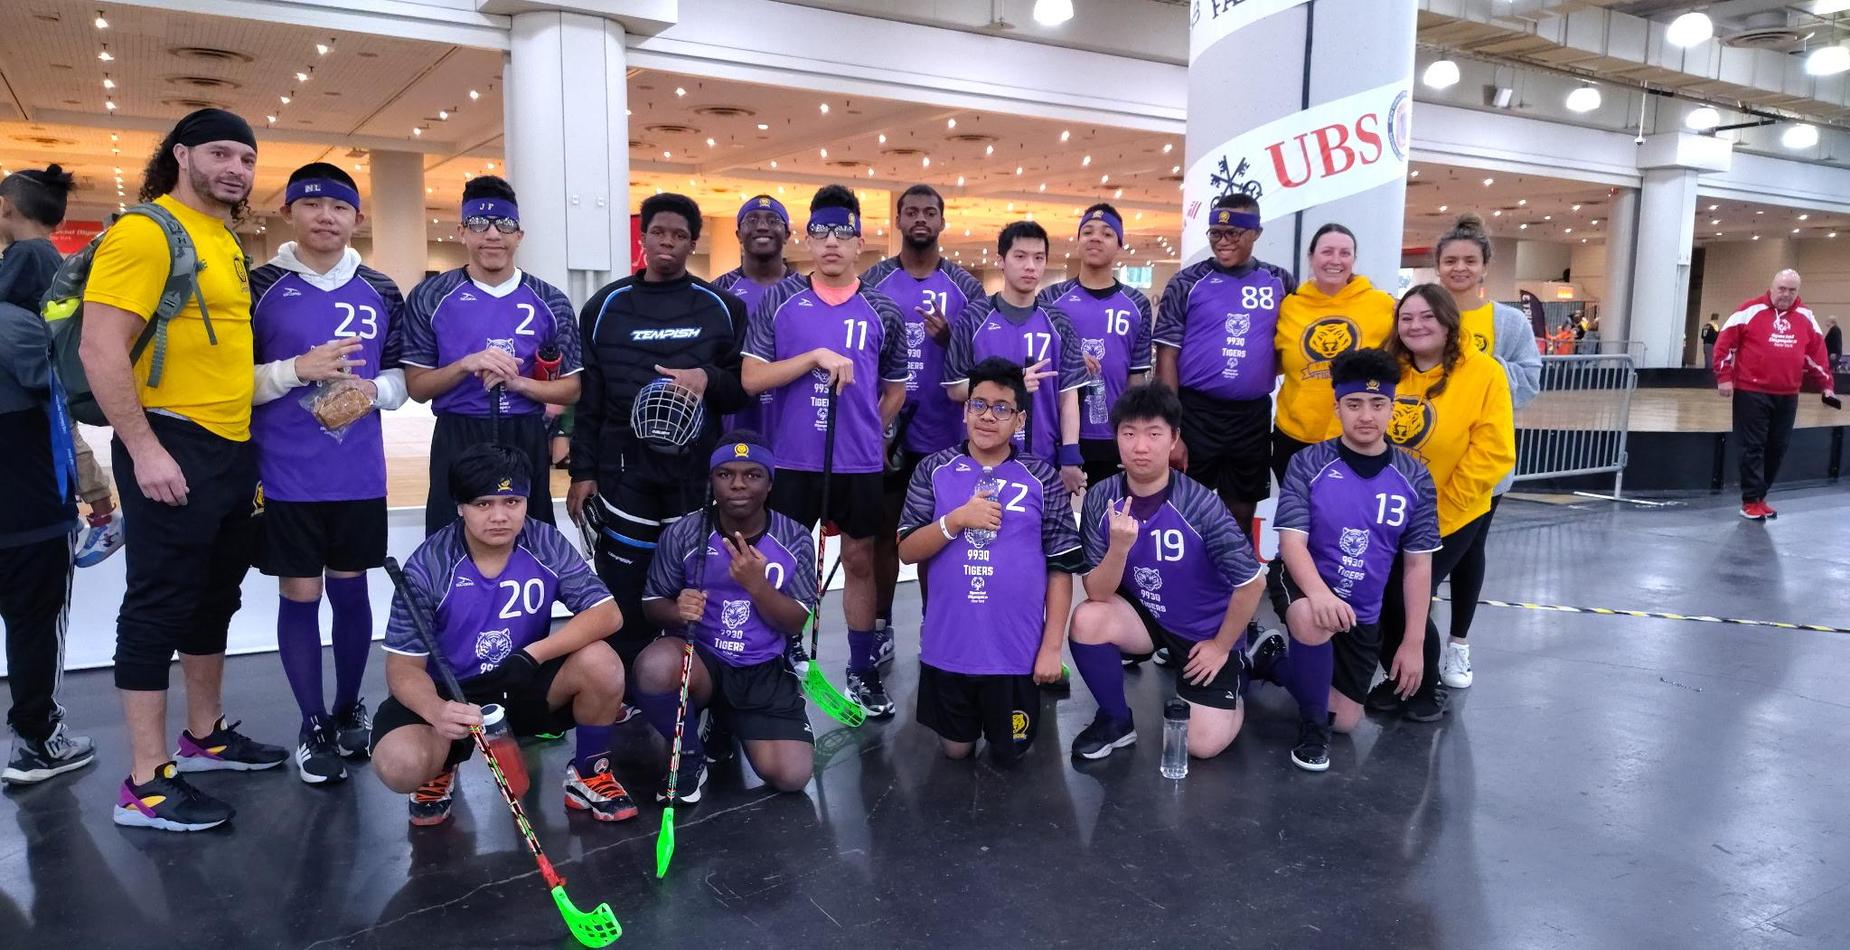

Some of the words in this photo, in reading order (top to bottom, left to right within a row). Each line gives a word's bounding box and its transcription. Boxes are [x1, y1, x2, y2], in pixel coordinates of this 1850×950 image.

[1264, 113, 1383, 189] UBS
[922, 289, 948, 316] 31
[1241, 286, 1274, 310] 88
[334, 302, 378, 339] 23
[515, 303, 535, 336] 2
[1104, 308, 1131, 335] 16
[630, 327, 702, 341] TEMPISH
[843, 318, 868, 350] 11
[1023, 332, 1051, 361] 17
[814, 383, 829, 394] 993
[1375, 493, 1407, 527] 13
[1150, 529, 1185, 562] 19
[963, 564, 994, 576] TIGERS
[1337, 564, 1365, 581] TIGERS
[498, 578, 546, 619] 20
[714, 637, 745, 652] TIGERS
